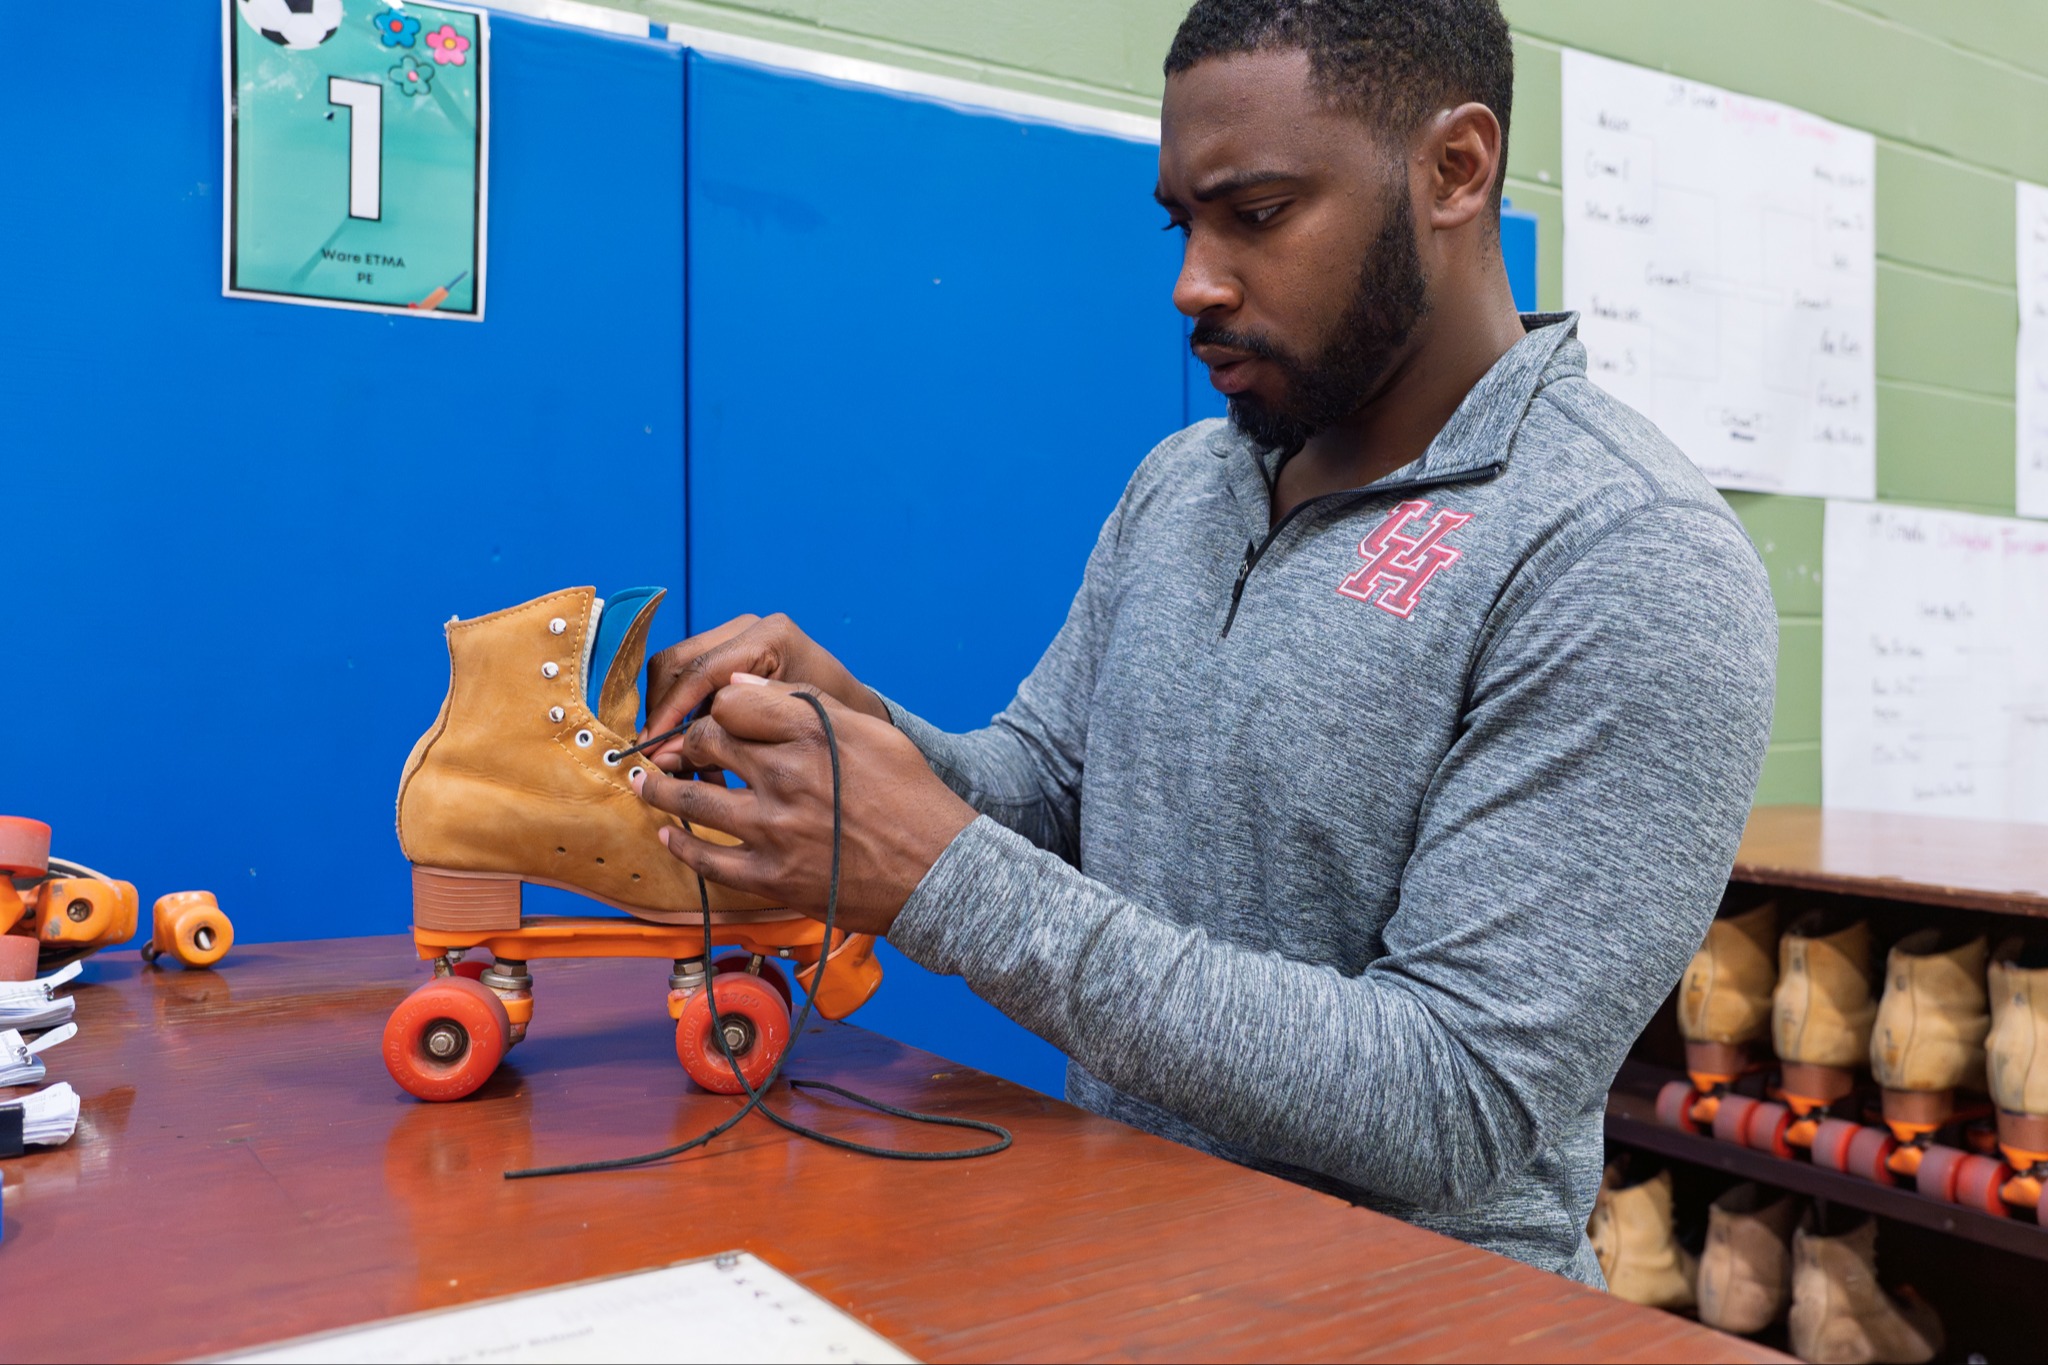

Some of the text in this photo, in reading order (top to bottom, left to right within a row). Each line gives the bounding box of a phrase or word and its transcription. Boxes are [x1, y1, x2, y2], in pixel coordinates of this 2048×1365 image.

[328, 75, 383, 222] 1
[321, 247, 406, 270] Ware ETMA
[357, 271, 374, 285] PE
